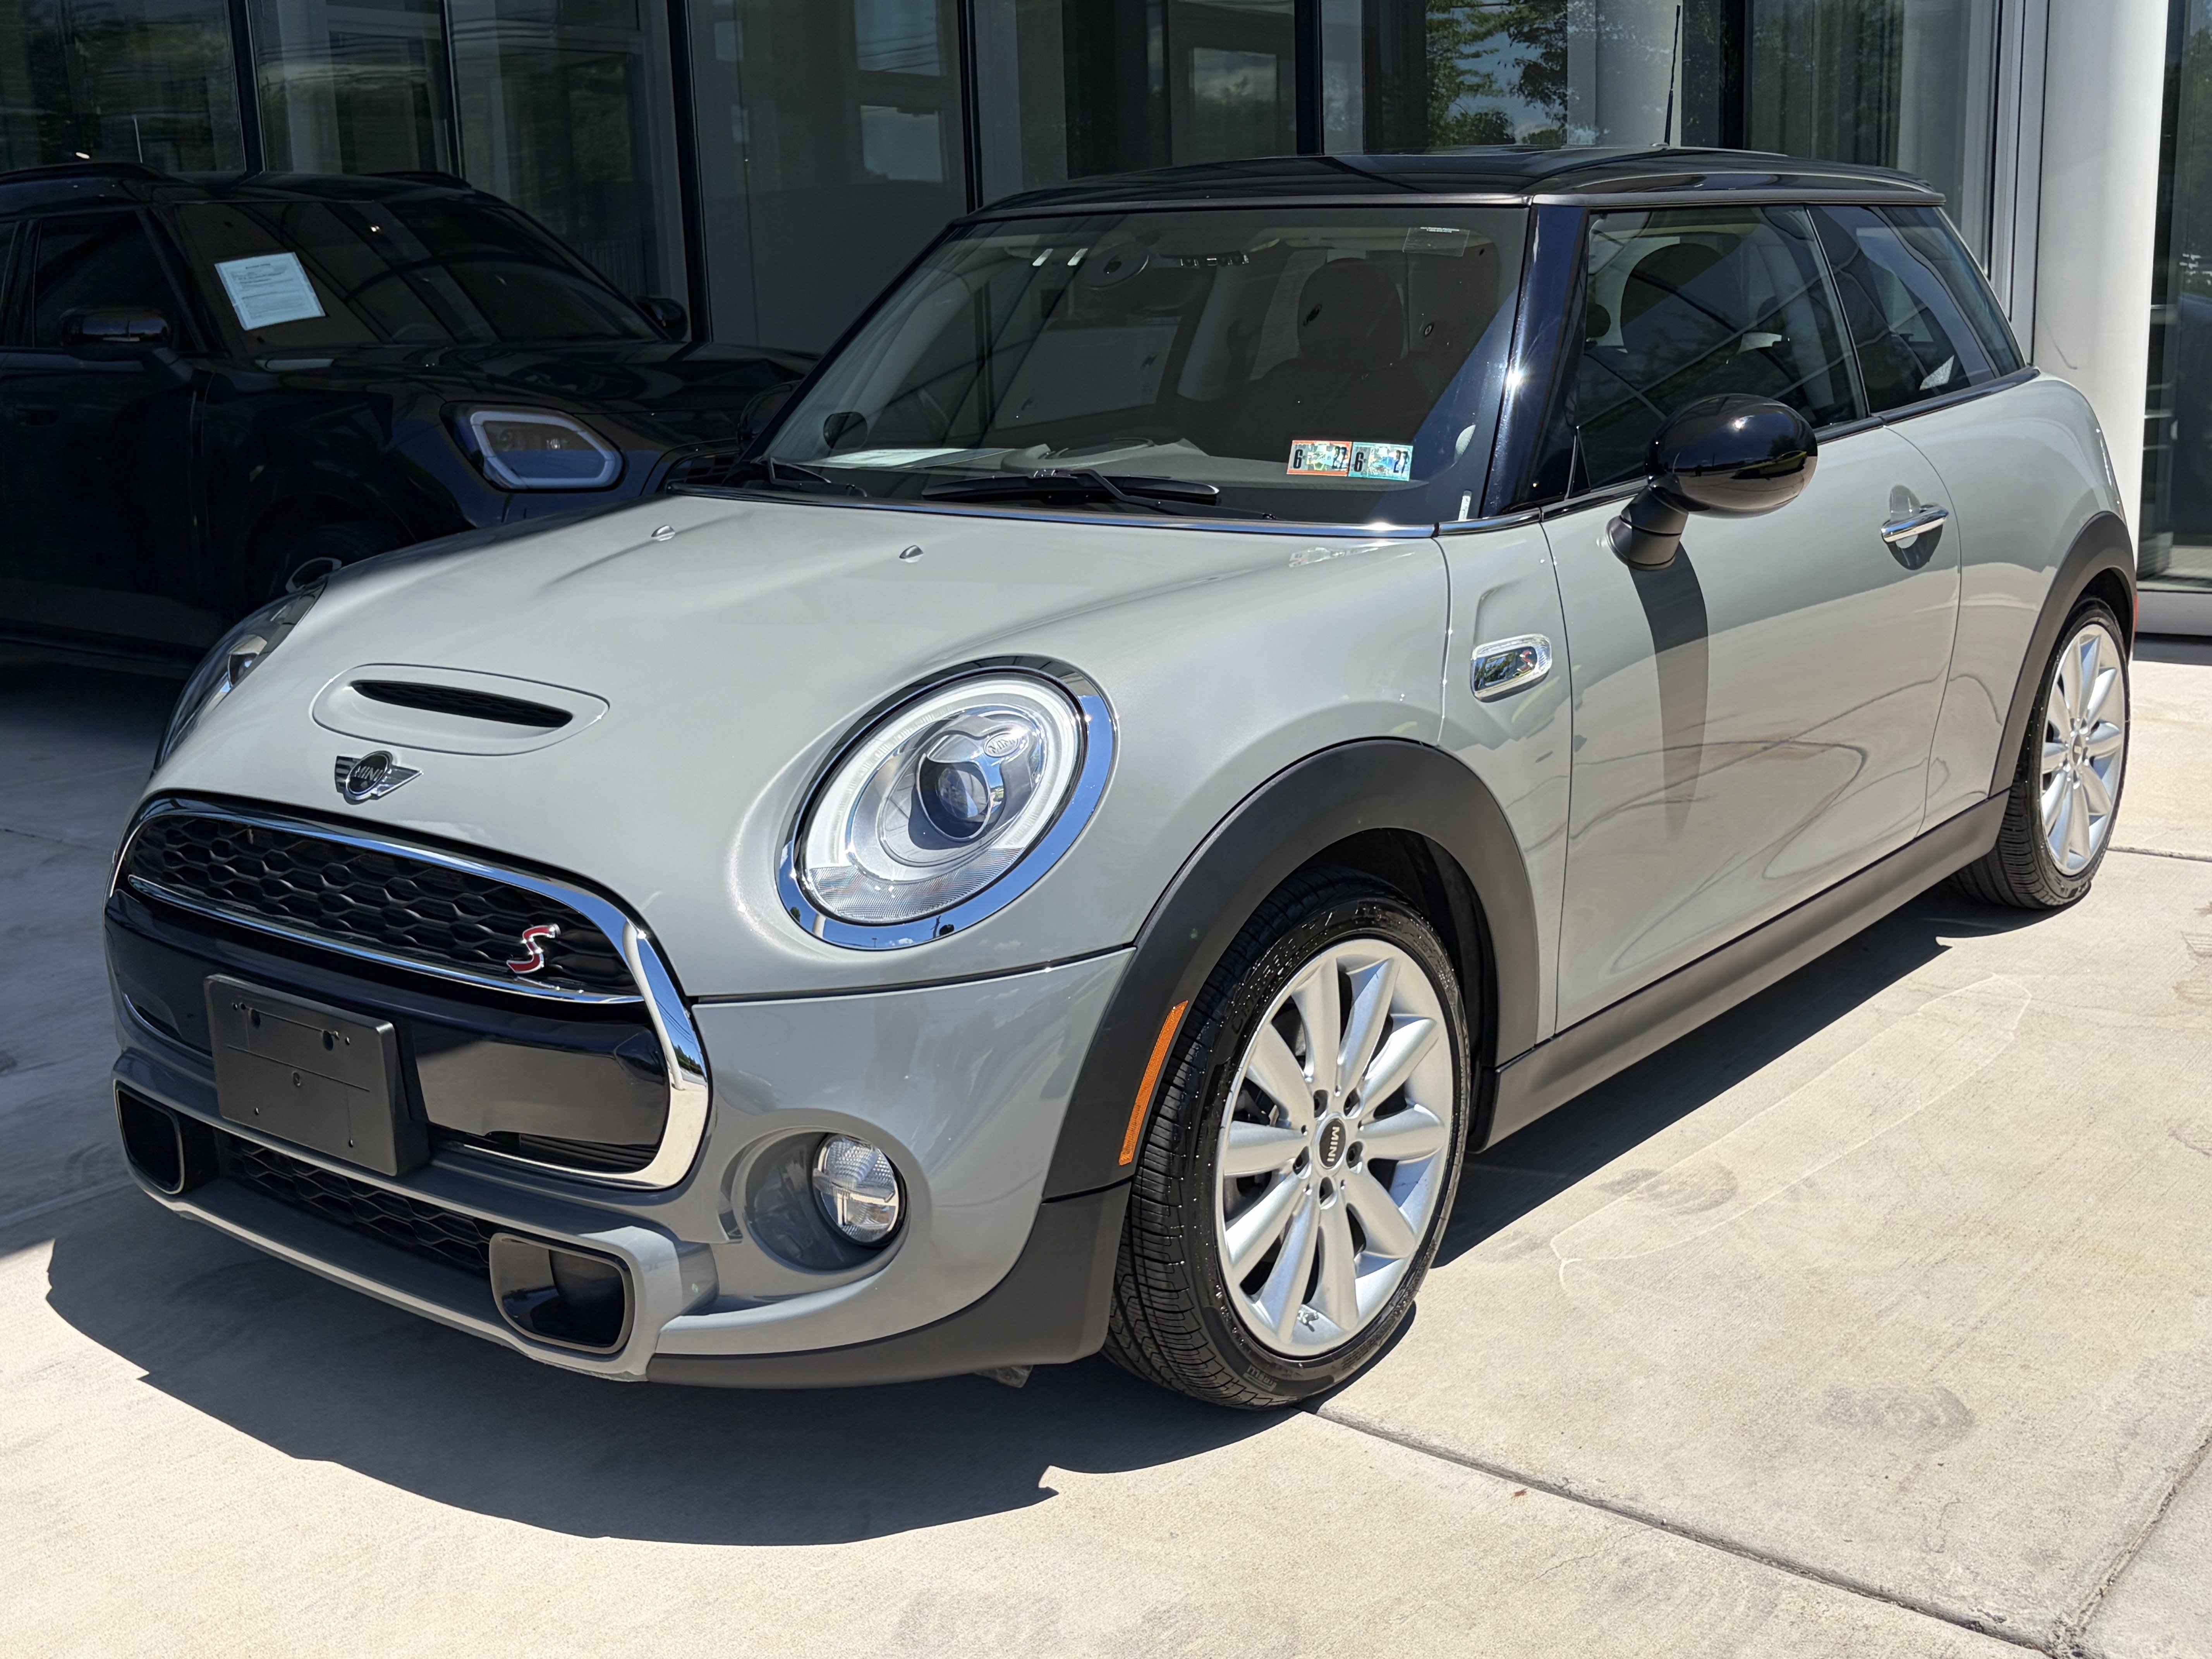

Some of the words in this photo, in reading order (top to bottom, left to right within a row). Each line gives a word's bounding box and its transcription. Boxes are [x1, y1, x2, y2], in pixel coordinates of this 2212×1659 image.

[1293, 449, 1303, 469] 6
[1353, 452, 1364, 472] 6
[1393, 450, 1408, 475] 27
[354, 765, 383, 781] MINI
[506, 923, 561, 974] S
[1327, 1126, 1340, 1162] MINI
[1243, 1365, 1277, 1392] PIRELLI
